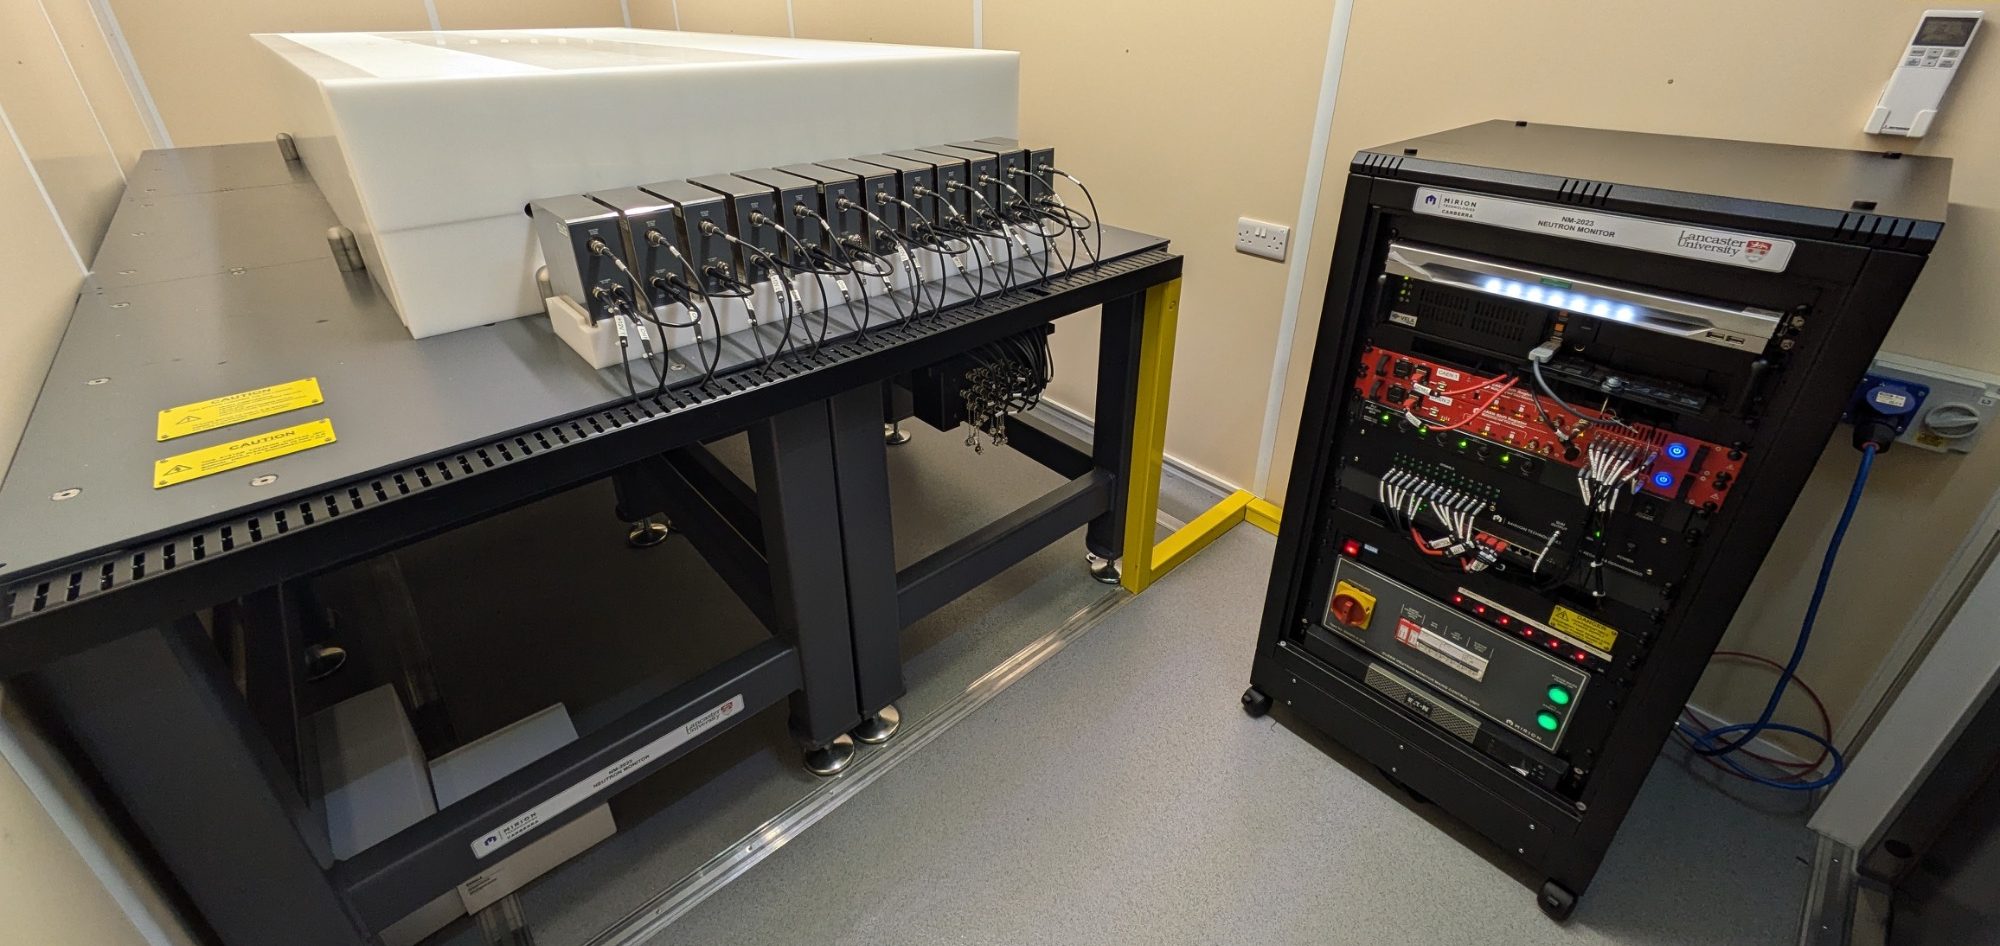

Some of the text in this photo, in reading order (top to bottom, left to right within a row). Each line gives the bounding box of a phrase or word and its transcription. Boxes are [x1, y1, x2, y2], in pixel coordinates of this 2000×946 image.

[1444, 198, 1477, 207] MIRION
[1537, 220, 1615, 238] NEUTRON MONITOR
[1561, 216, 1594, 227] NM-2023
[1677, 237, 1741, 257] University
[1680, 230, 1746, 248] Lancaster
[211, 388, 272, 405] CAUTION
[229, 430, 296, 451] CAUTION
